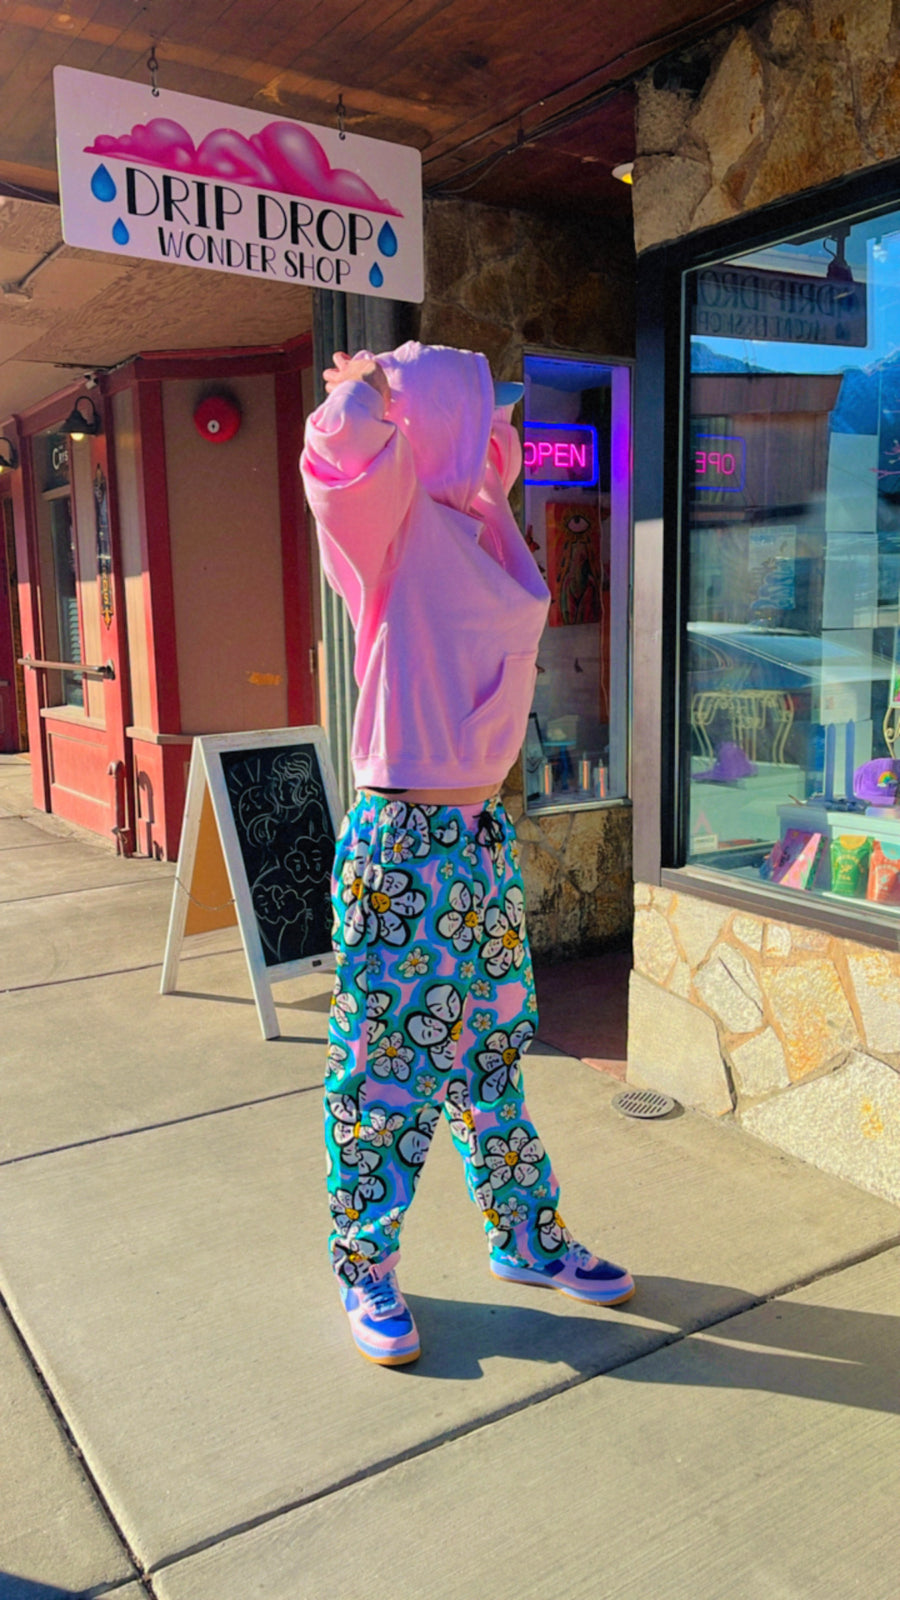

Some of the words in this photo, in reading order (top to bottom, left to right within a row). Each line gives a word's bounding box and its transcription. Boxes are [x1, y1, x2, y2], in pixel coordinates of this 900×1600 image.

[125, 167, 243, 231] DRIP
[257, 194, 374, 256] DROP
[157, 226, 277, 275] WONDER
[283, 250, 352, 285] SHOP
[523, 441, 586, 468] OPEN
